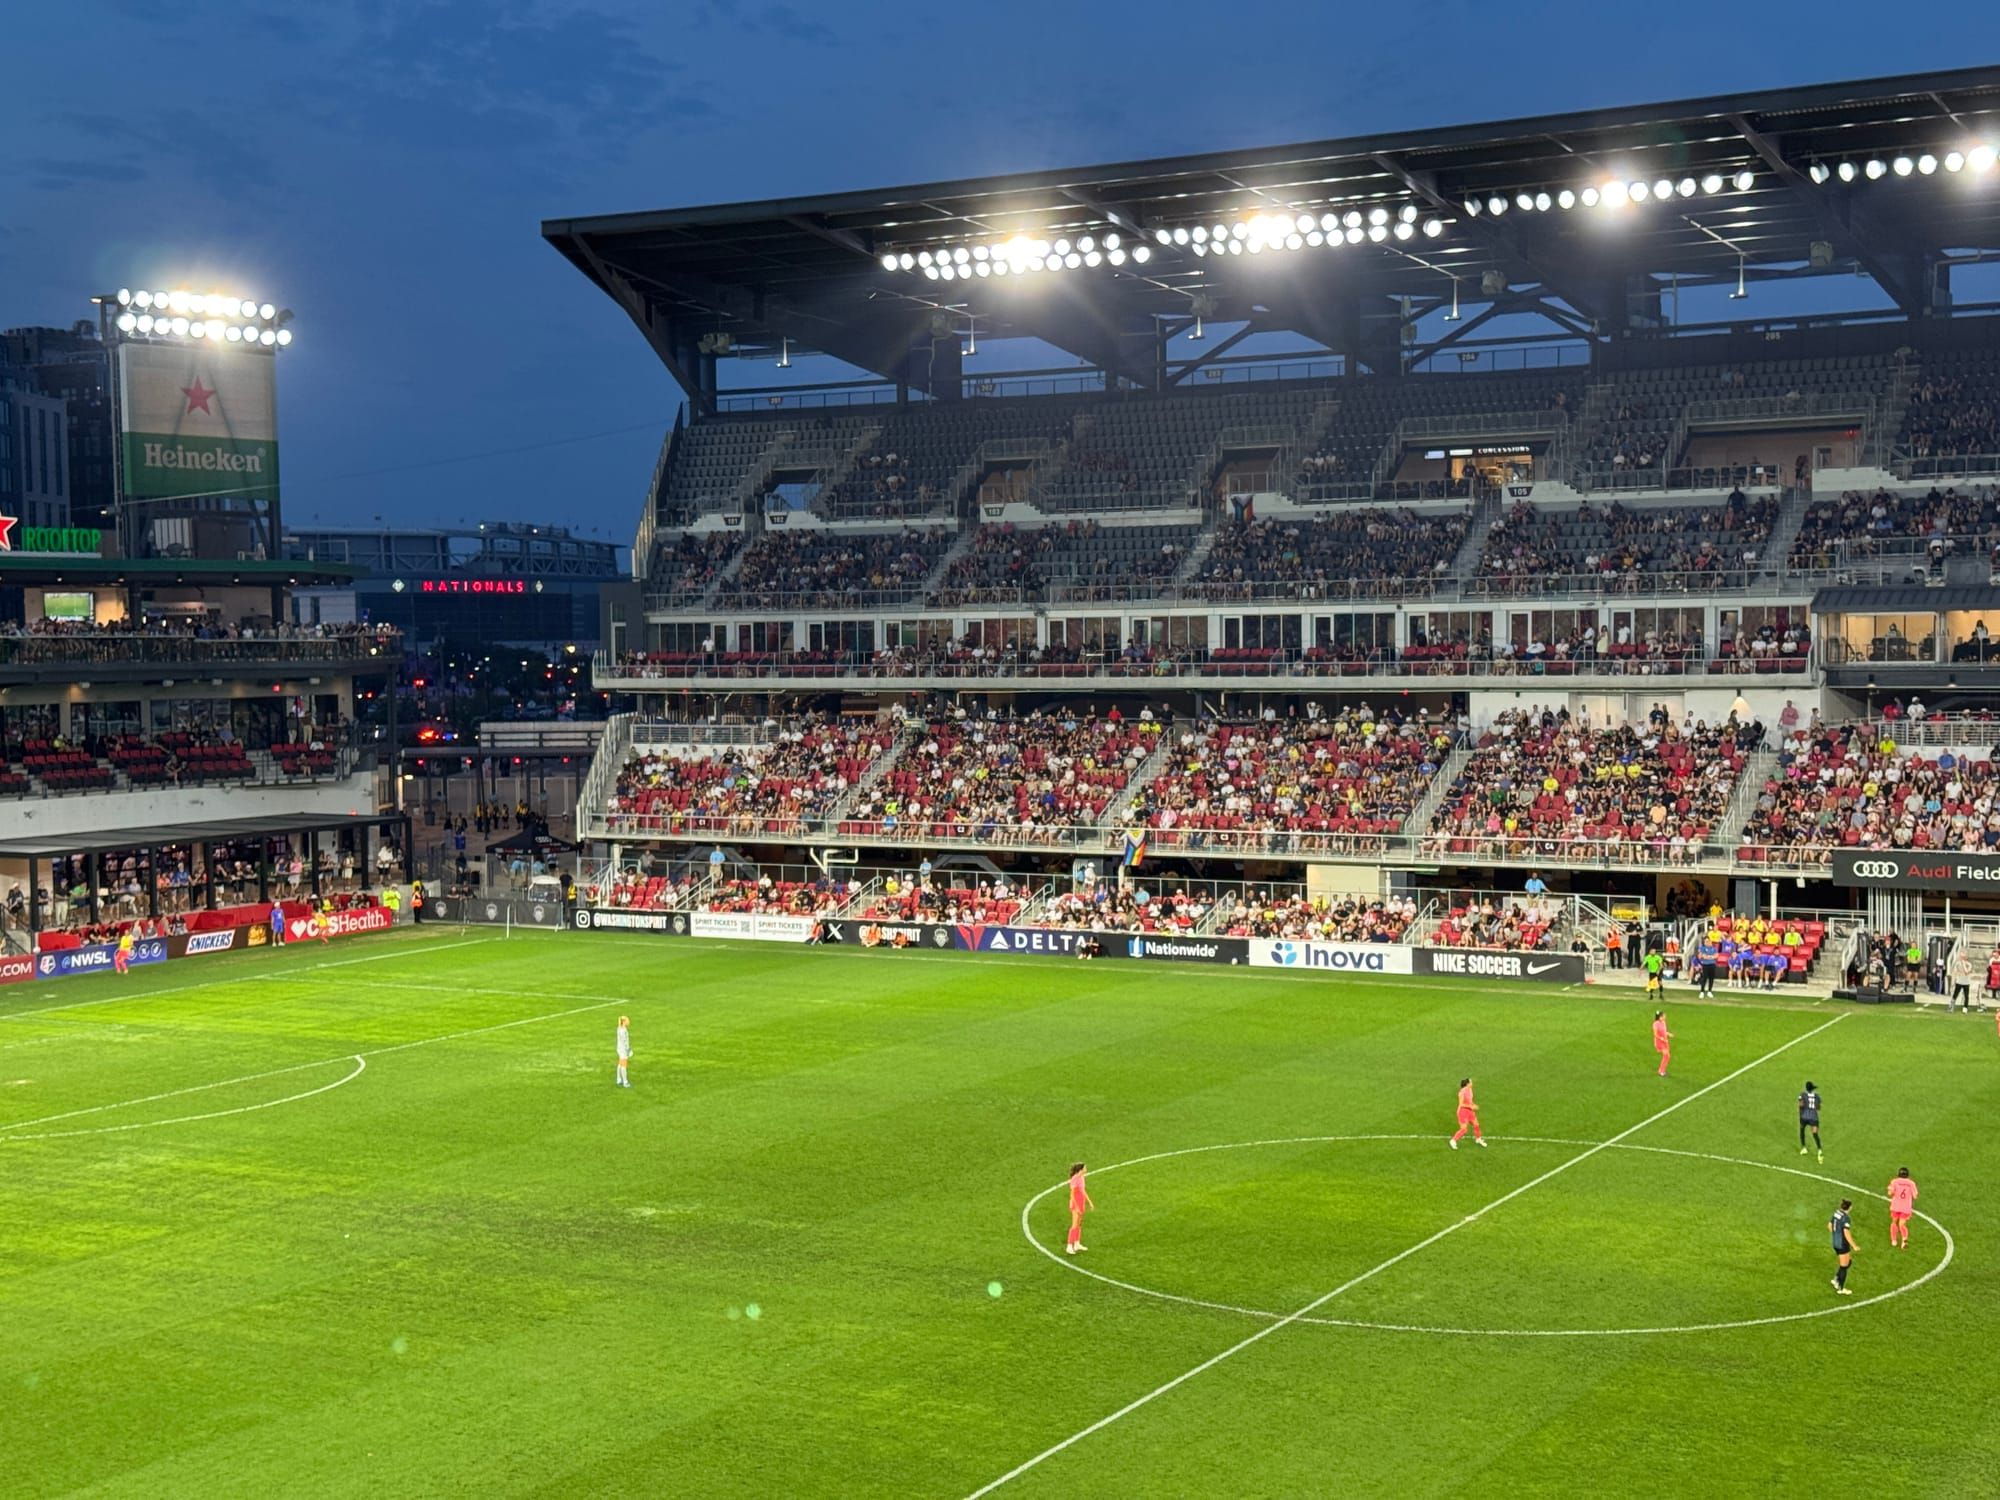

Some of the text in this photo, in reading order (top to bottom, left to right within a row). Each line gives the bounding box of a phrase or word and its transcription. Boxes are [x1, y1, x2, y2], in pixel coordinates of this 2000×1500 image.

[144, 443, 262, 472] Heineken
[24, 527, 101, 551] ROOFTOP
[423, 581, 524, 592] NATIONALS
[1907, 864, 1952, 878] Audi
[189, 933, 232, 951] SNICKERS
[1014, 933, 1087, 951] DELTA
[1145, 942, 1216, 957] Nationwide
[61, 952, 111, 968] @NWSL
[1305, 943, 1384, 970] Inova
[1433, 953, 1522, 976] NIKE SOCCER
[0, 961, 32, 977] .COM
[1901, 1189, 1905, 1199] 6
